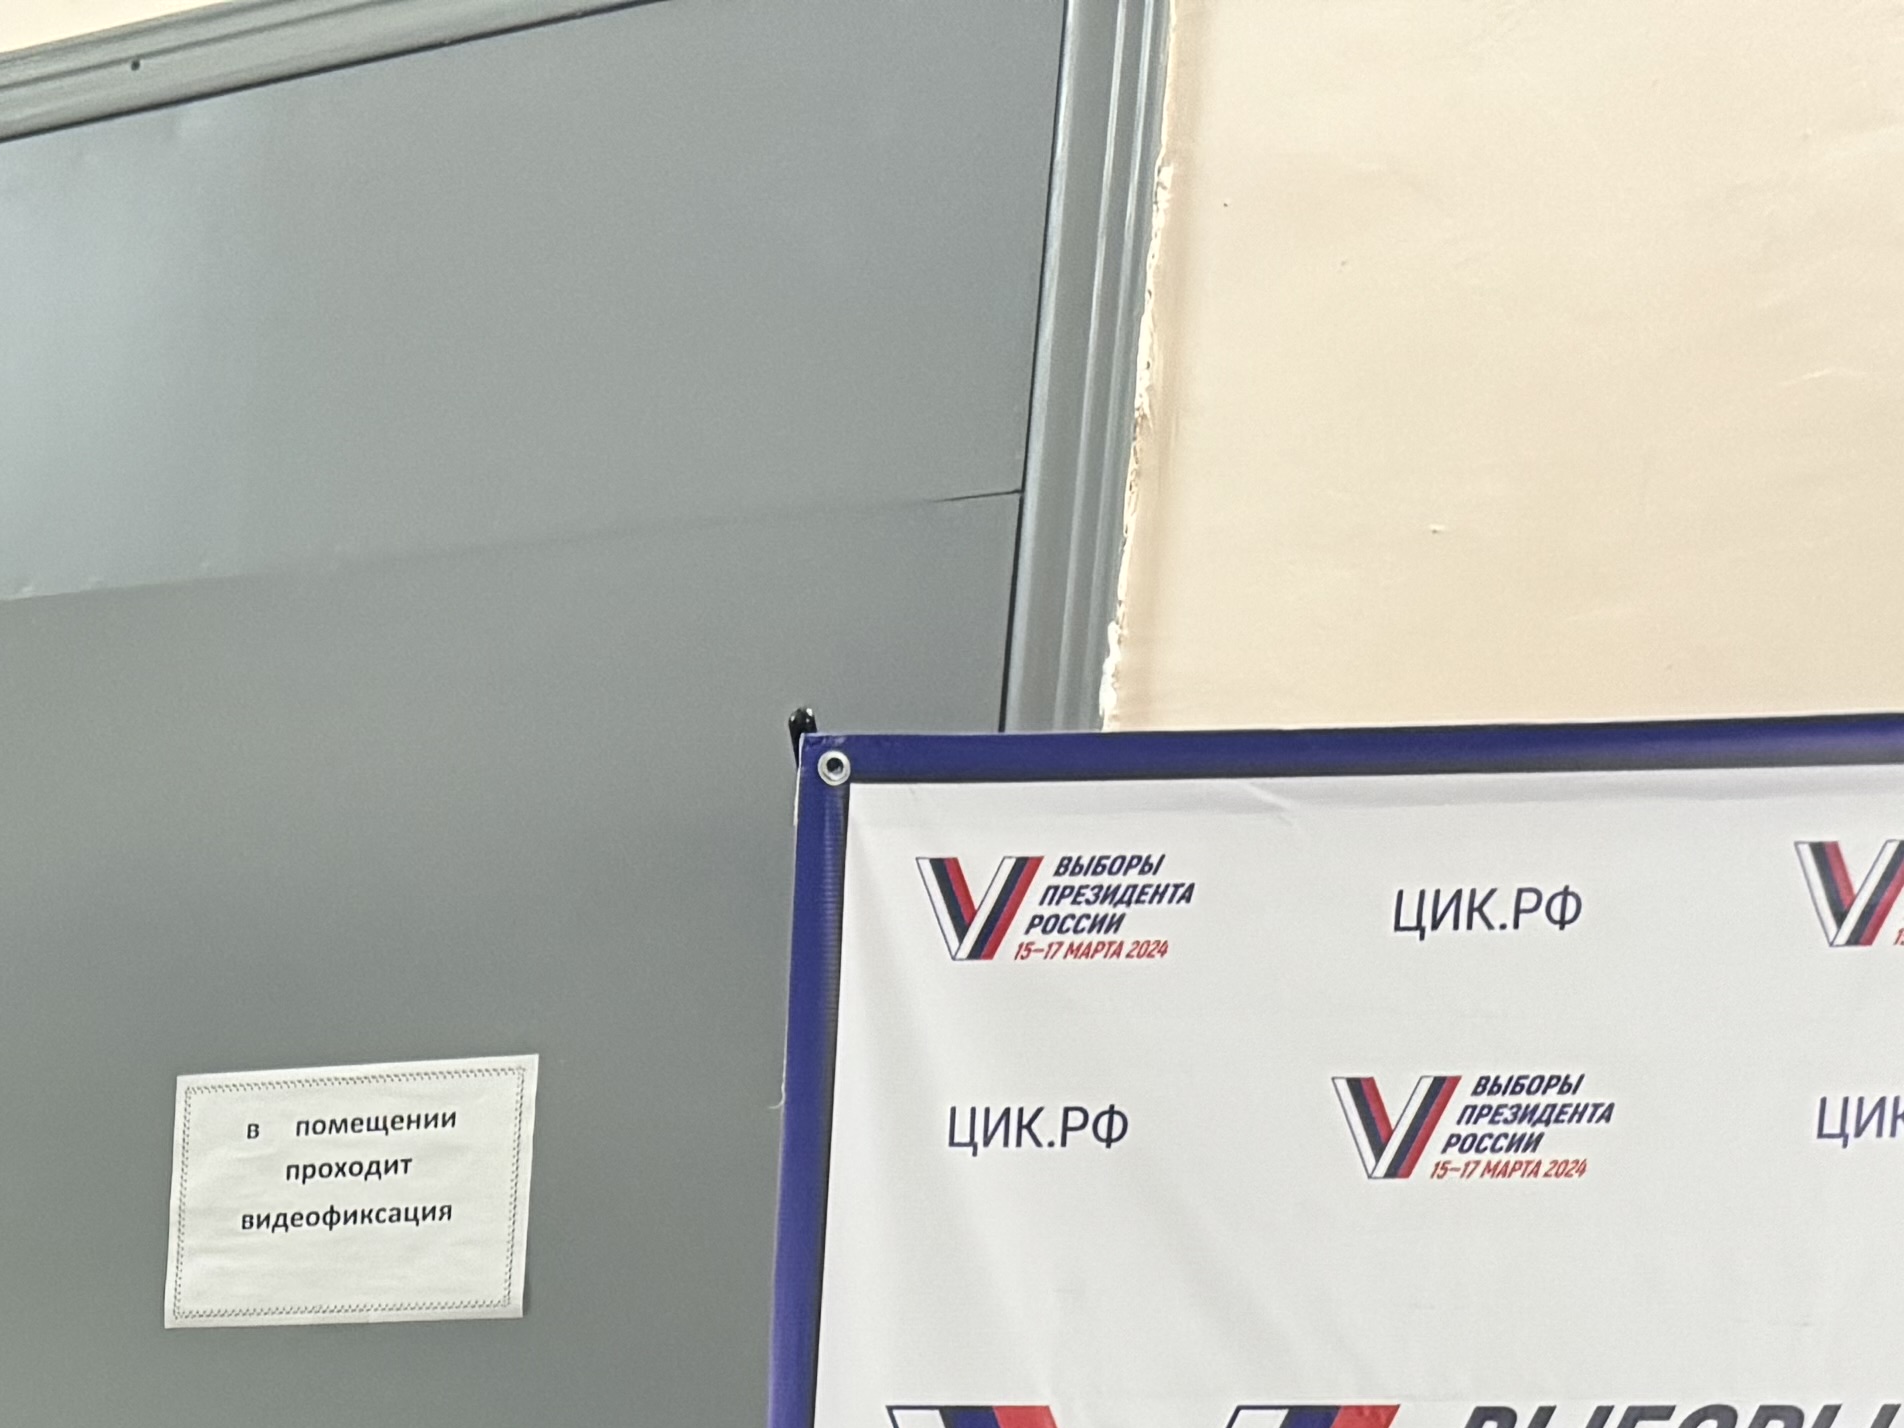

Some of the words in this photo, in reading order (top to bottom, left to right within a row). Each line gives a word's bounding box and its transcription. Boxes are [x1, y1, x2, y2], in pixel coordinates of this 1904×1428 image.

[1053, 854, 1166, 877] ВЫБОРЫ
[1039, 882, 1195, 908] ПРЕЗИДЕНТА
[1024, 913, 1126, 935] РОССИИ
[1394, 885, 1582, 941] ЦИК.РФ
[1063, 941, 1124, 959] МАРТА
[1125, 940, 1168, 959] 2024
[1471, 1073, 1585, 1096] ВЫБОРЫ
[296, 1111, 456, 1137] помещении
[1456, 1102, 1615, 1128] ПРЕЗИДЕНТА
[948, 1104, 1128, 1157] ЦИК.РФ
[1441, 1132, 1545, 1154] РОССИИ
[286, 1158, 413, 1185] проходит
[1480, 1160, 1542, 1178] МАРТА
[1543, 1159, 1587, 1178] 2024
[241, 1204, 452, 1234] видеофиксация
